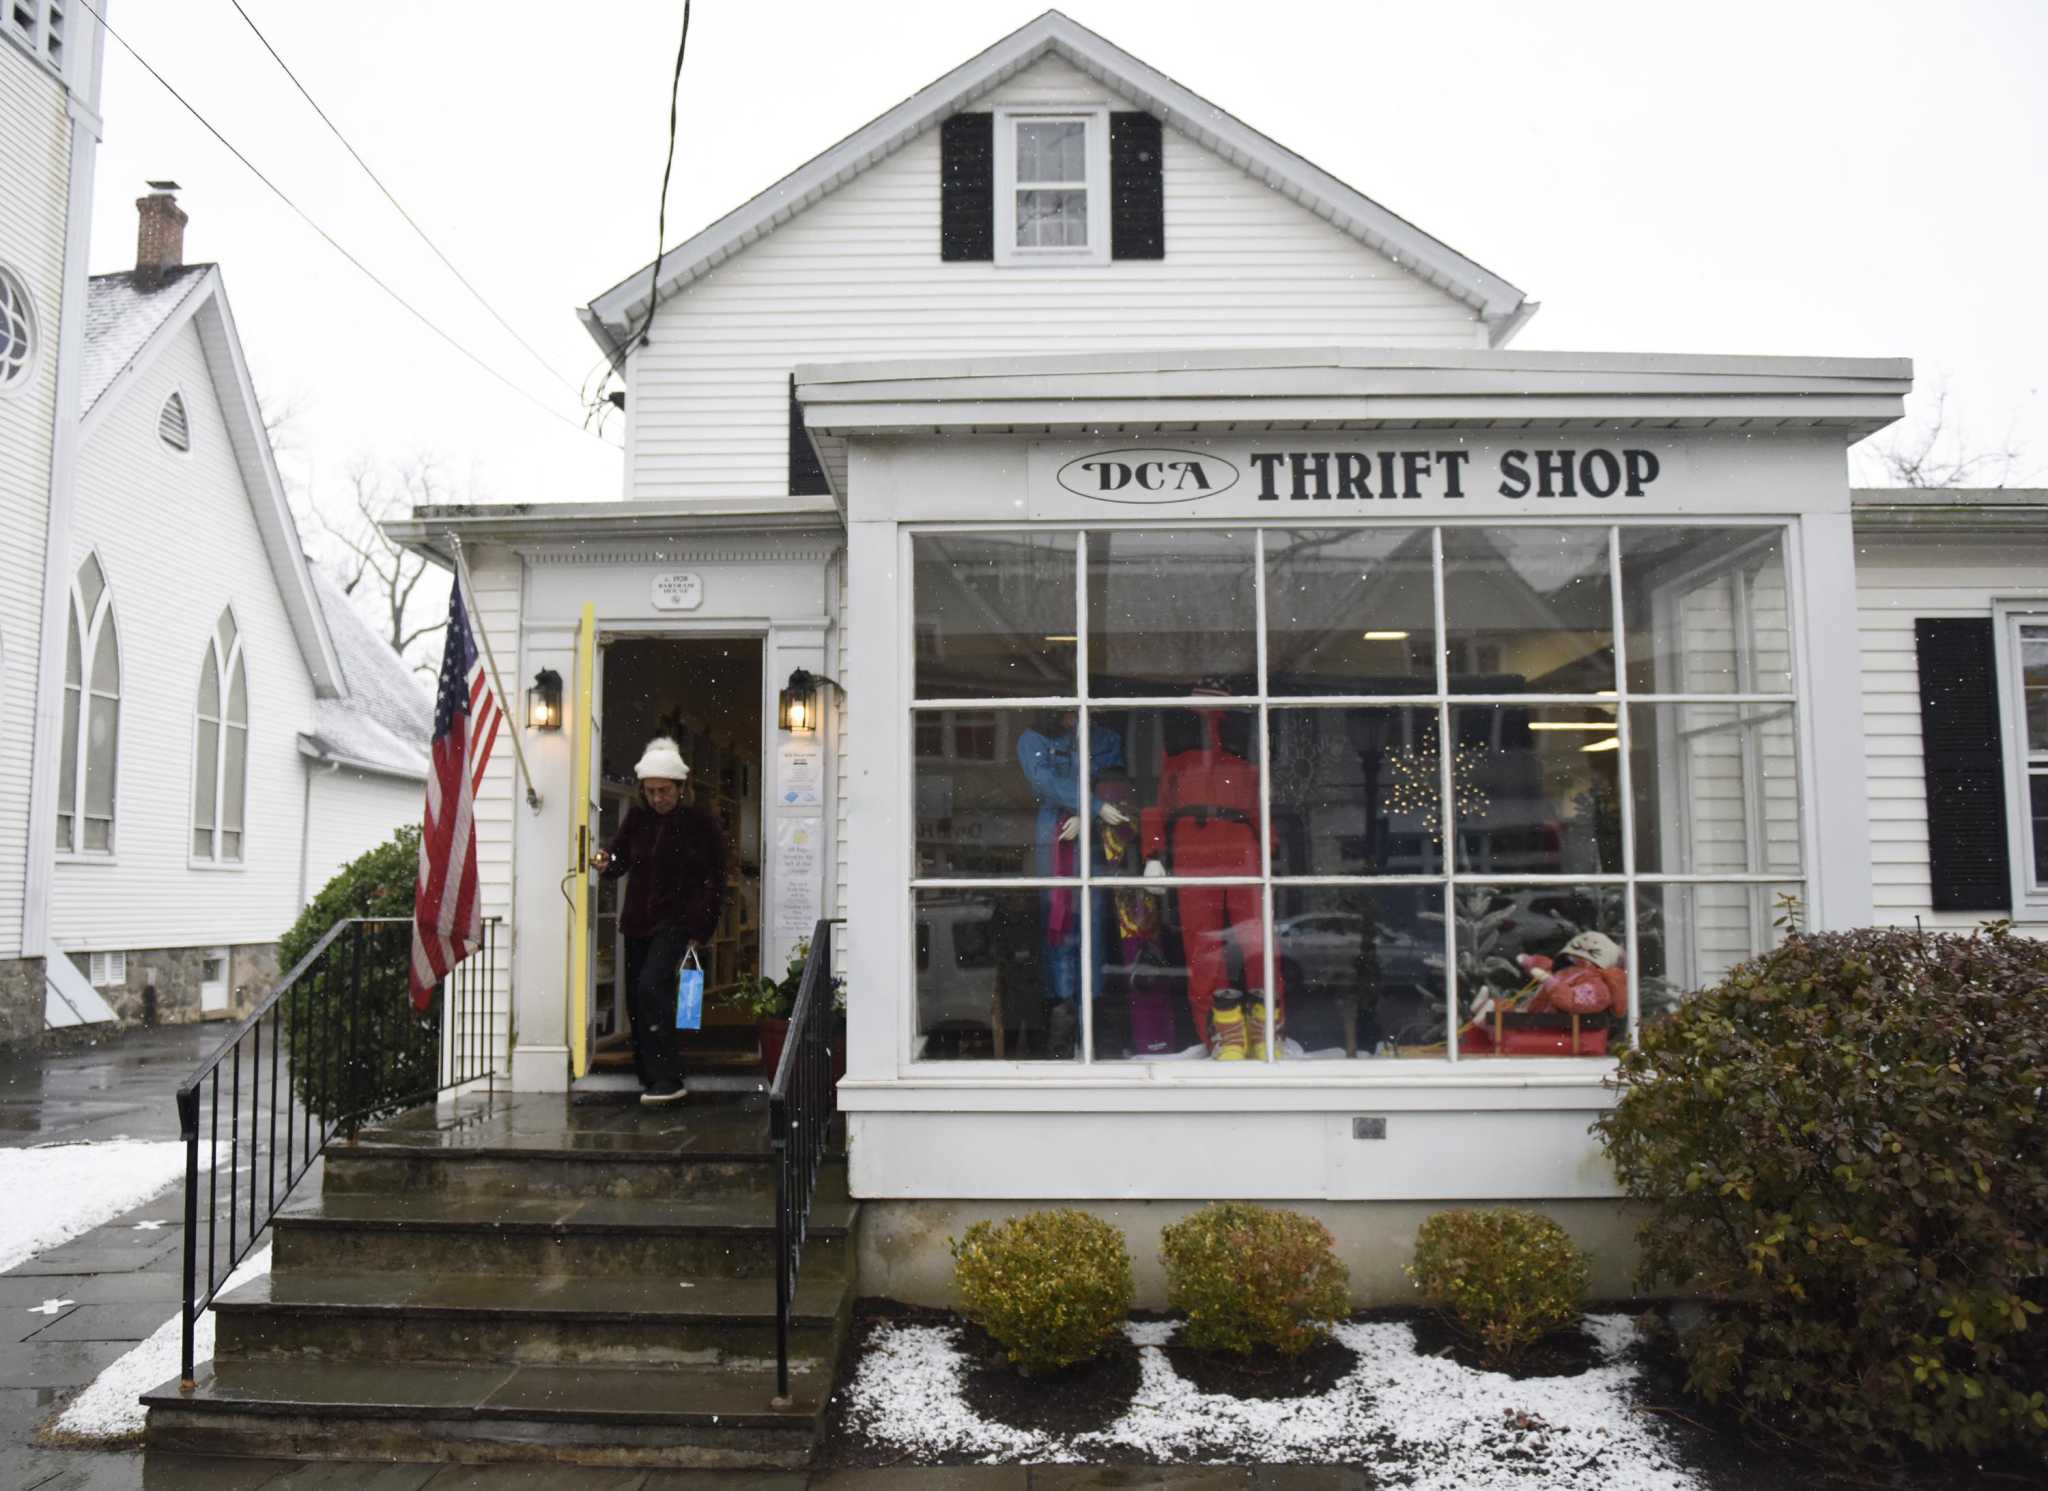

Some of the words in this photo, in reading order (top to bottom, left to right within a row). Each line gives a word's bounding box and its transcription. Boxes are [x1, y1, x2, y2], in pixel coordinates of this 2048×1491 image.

[1081, 461, 1213, 491] DCA
[1250, 449, 1470, 501] THRIFT
[1498, 448, 1660, 499] SHOP
